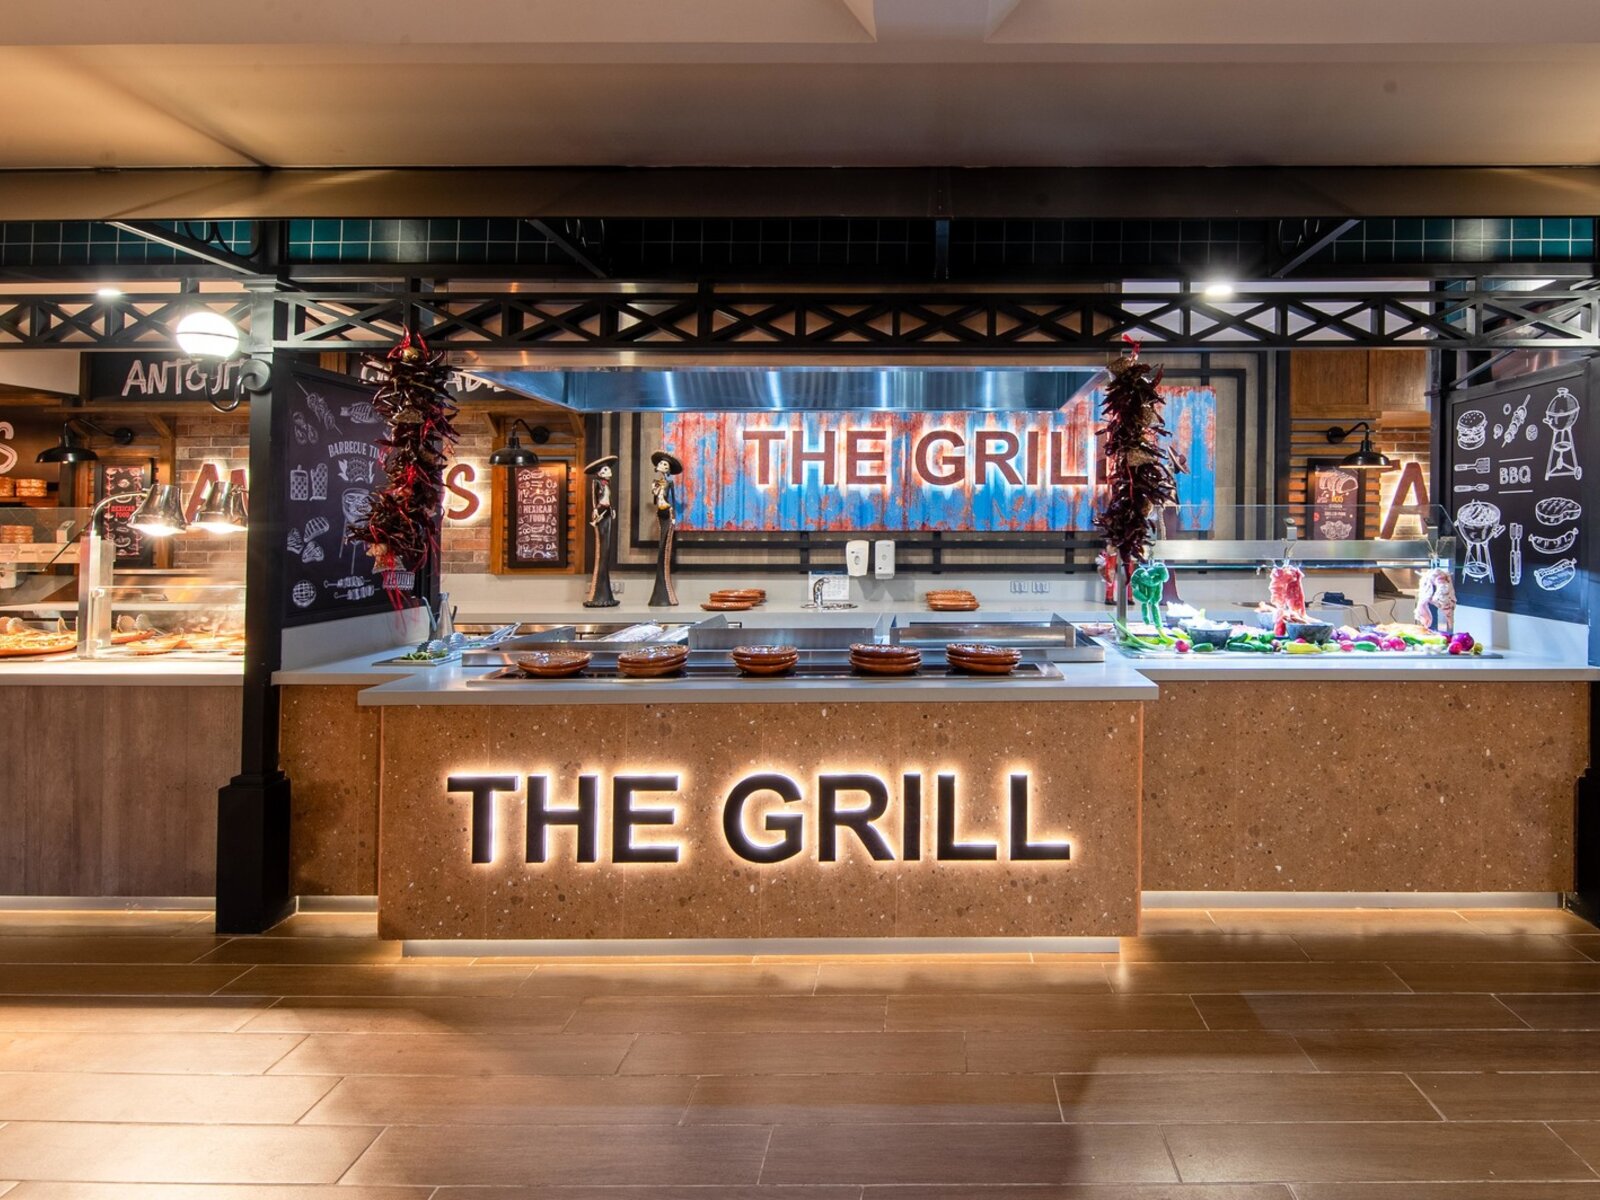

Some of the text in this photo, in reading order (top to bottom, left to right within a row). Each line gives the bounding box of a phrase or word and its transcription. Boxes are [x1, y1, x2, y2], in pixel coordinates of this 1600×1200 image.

[328, 440, 367, 458] BARBECUE
[743, 430, 887, 485] THE
[1499, 465, 1531, 485] BBQ
[522, 504, 553, 514] MEXICAN
[446, 773, 1071, 864] THE GRILL
